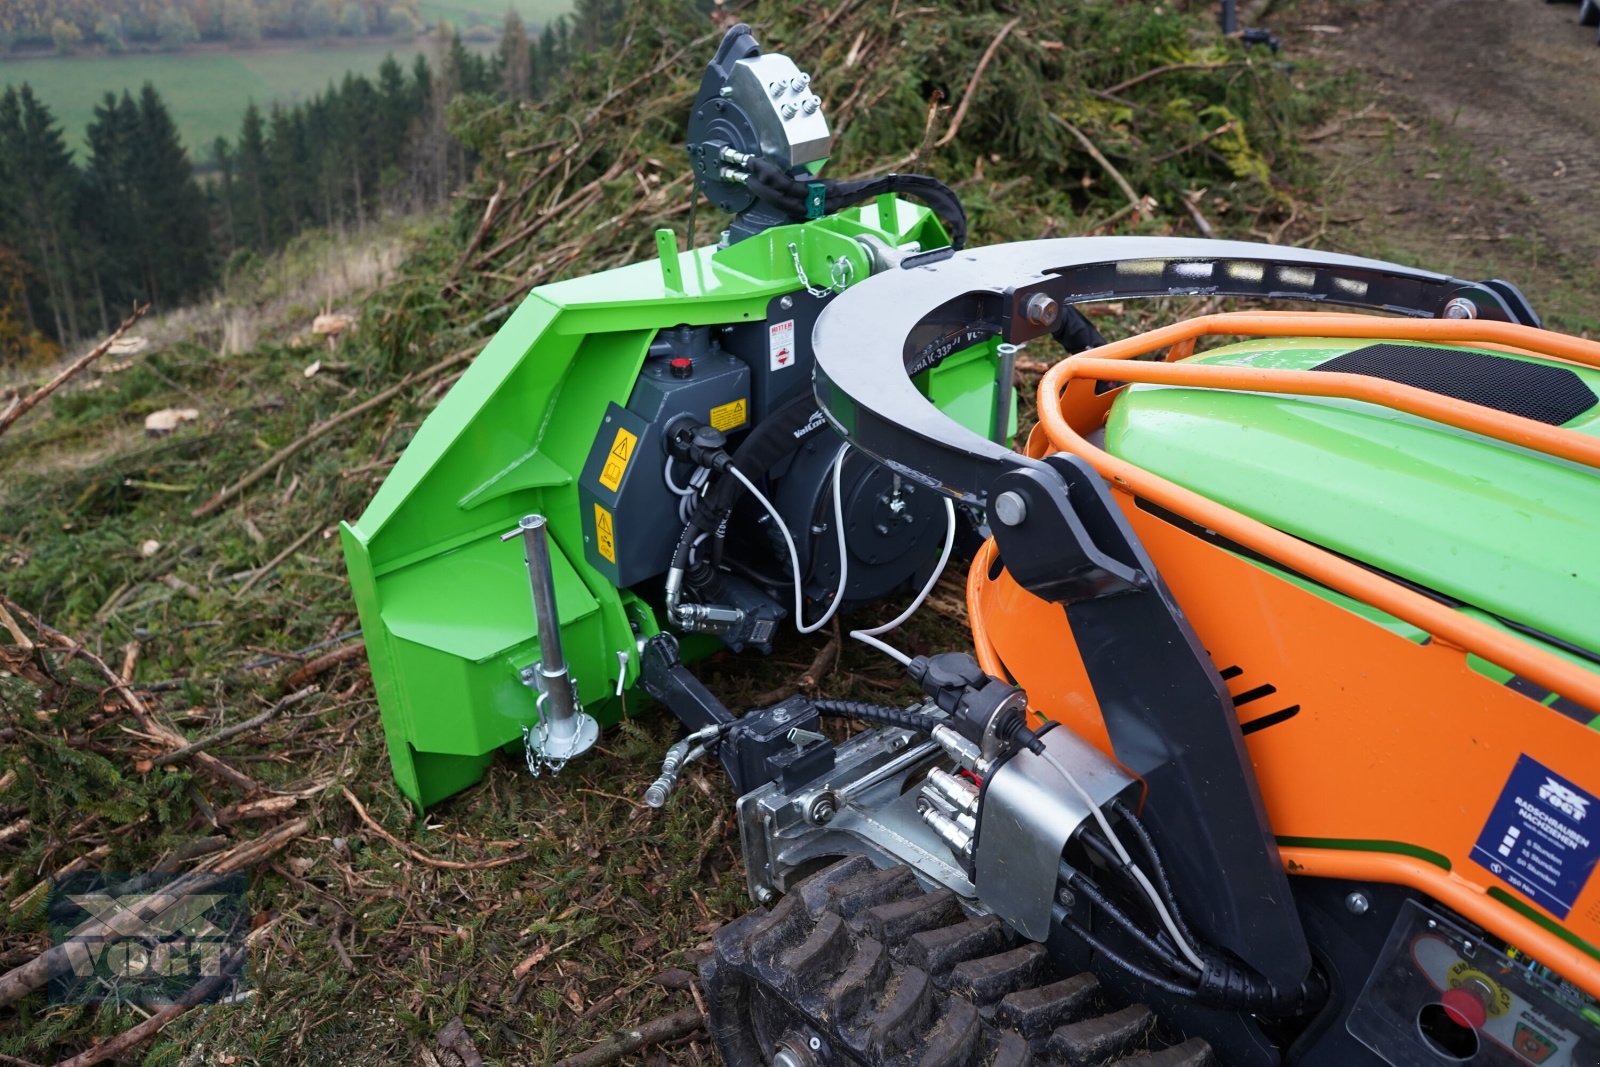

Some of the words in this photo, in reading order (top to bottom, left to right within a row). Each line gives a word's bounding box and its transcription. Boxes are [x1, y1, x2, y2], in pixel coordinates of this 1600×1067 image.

[771, 321, 792, 334] RITTER
[793, 418, 826, 439] ValCon
[1515, 797, 1589, 848] RADSCHRAUBEN
[1518, 809, 1578, 850] NACHZIEHEN
[1530, 853, 1561, 878] Stunden
[1532, 842, 1562, 866] Stunden
[1526, 863, 1557, 887] Stunden
